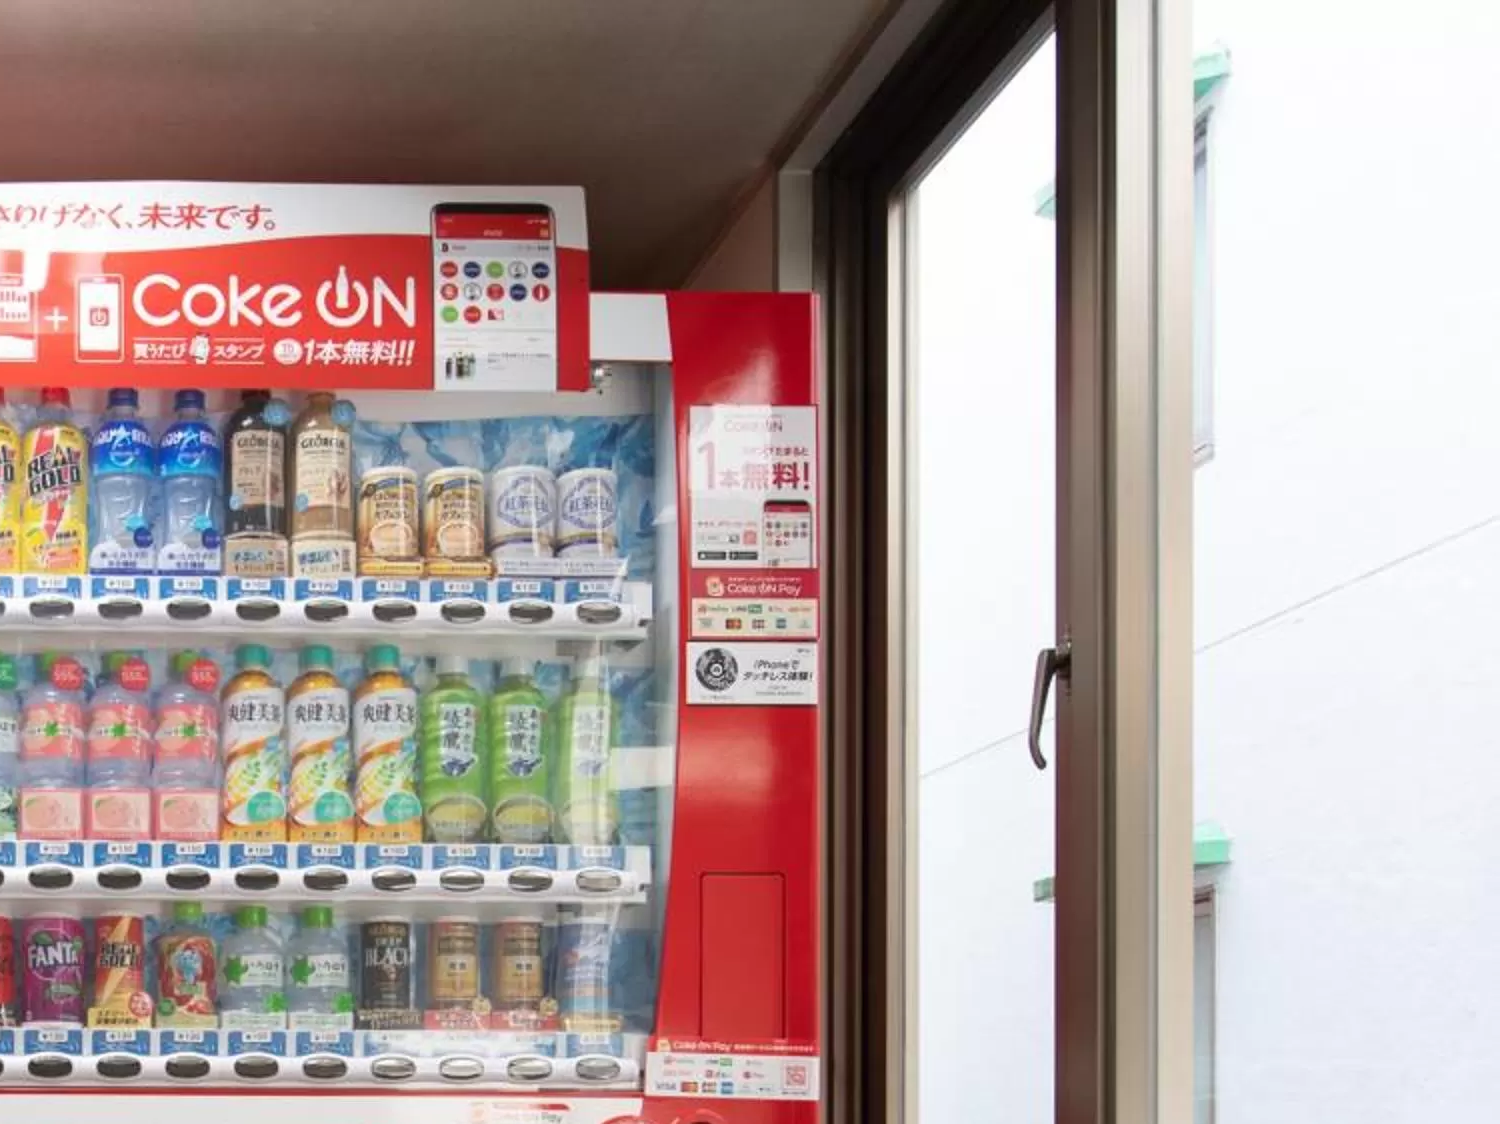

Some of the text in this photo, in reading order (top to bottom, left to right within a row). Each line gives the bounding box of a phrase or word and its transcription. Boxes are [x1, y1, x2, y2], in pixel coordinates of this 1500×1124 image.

[132, 265, 416, 328] Coke ON
[213, 342, 266, 359] スタンプ
[303, 339, 416, 367] 1本無料!!
[27, 445, 80, 479] REAL
[29, 464, 82, 497] GOLD
[27, 941, 80, 968] FANTA
